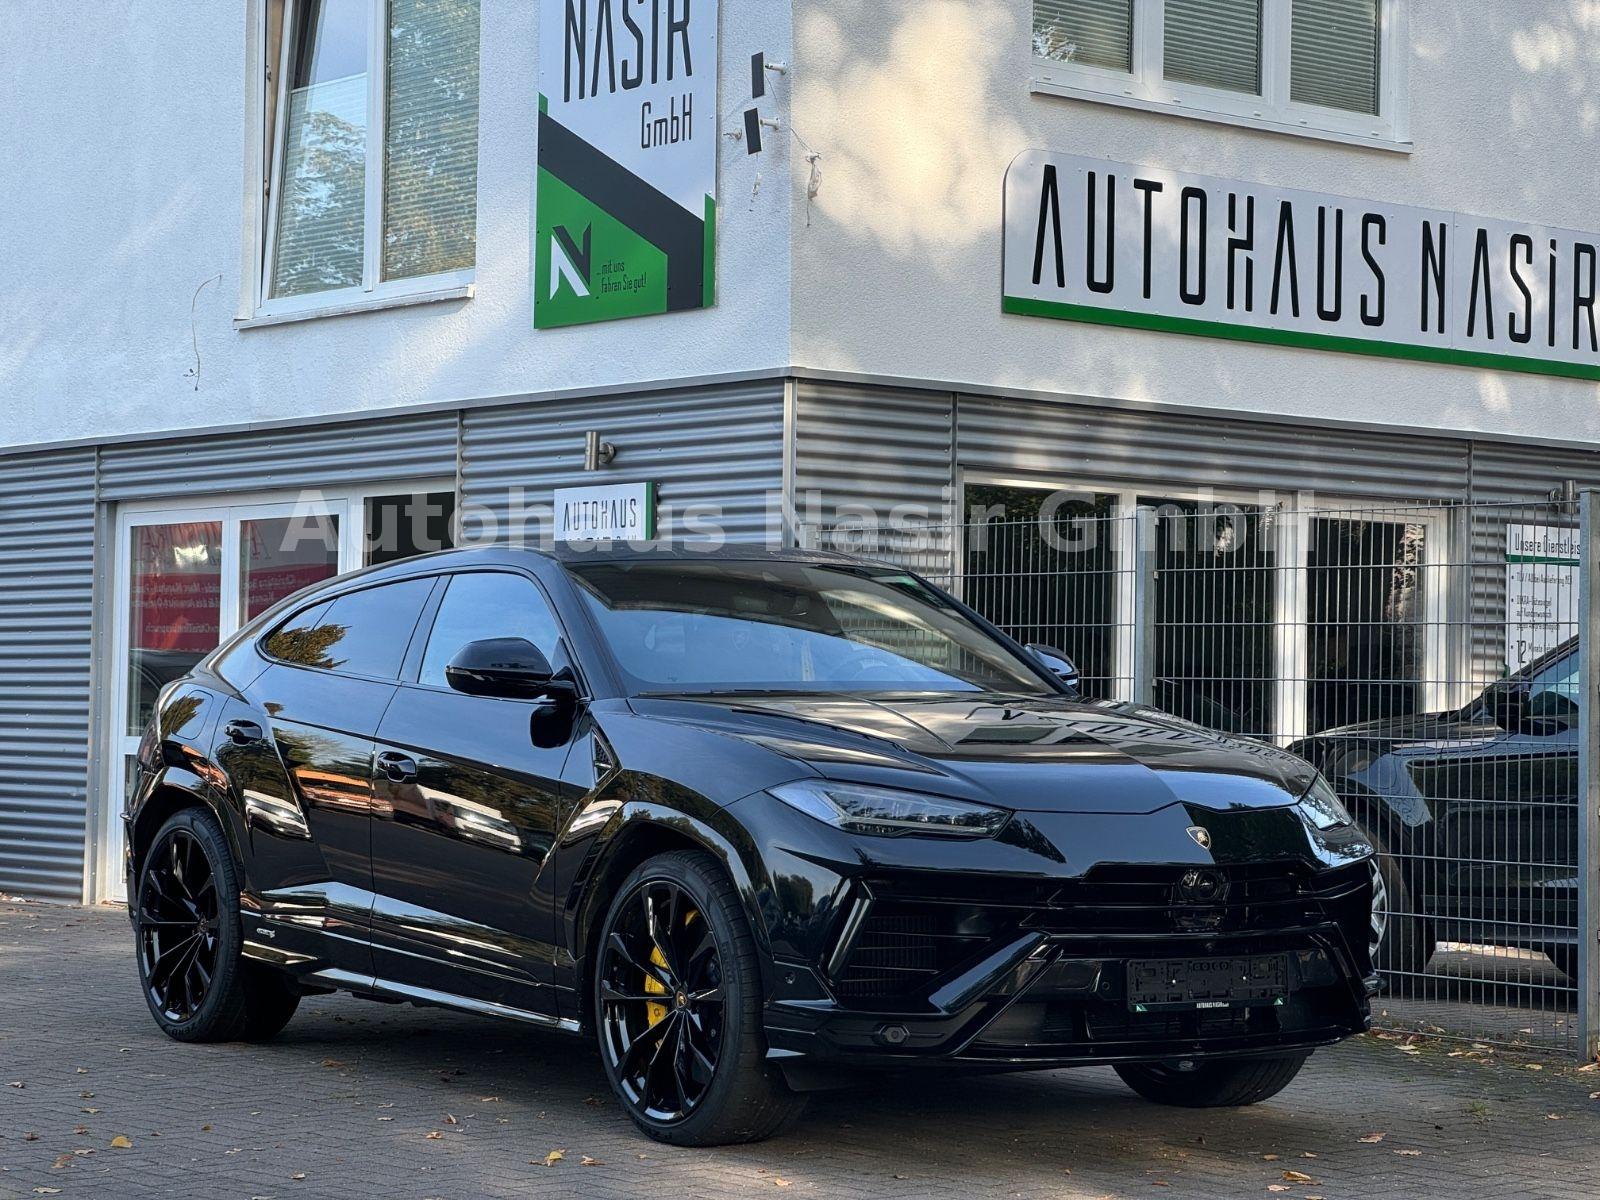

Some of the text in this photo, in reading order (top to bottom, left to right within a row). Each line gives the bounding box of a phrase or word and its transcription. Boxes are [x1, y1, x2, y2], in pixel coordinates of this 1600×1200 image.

[641, 93, 692, 149] GmbH
[1031, 164, 1387, 327] AUTOHAUS
[613, 262, 625, 273] uns
[601, 271, 647, 293] fahren Sie gut!
[563, 498, 637, 531] AUTOHAUS
[1515, 532, 1542, 552] Unsere
[1517, 640, 1527, 663] 12
